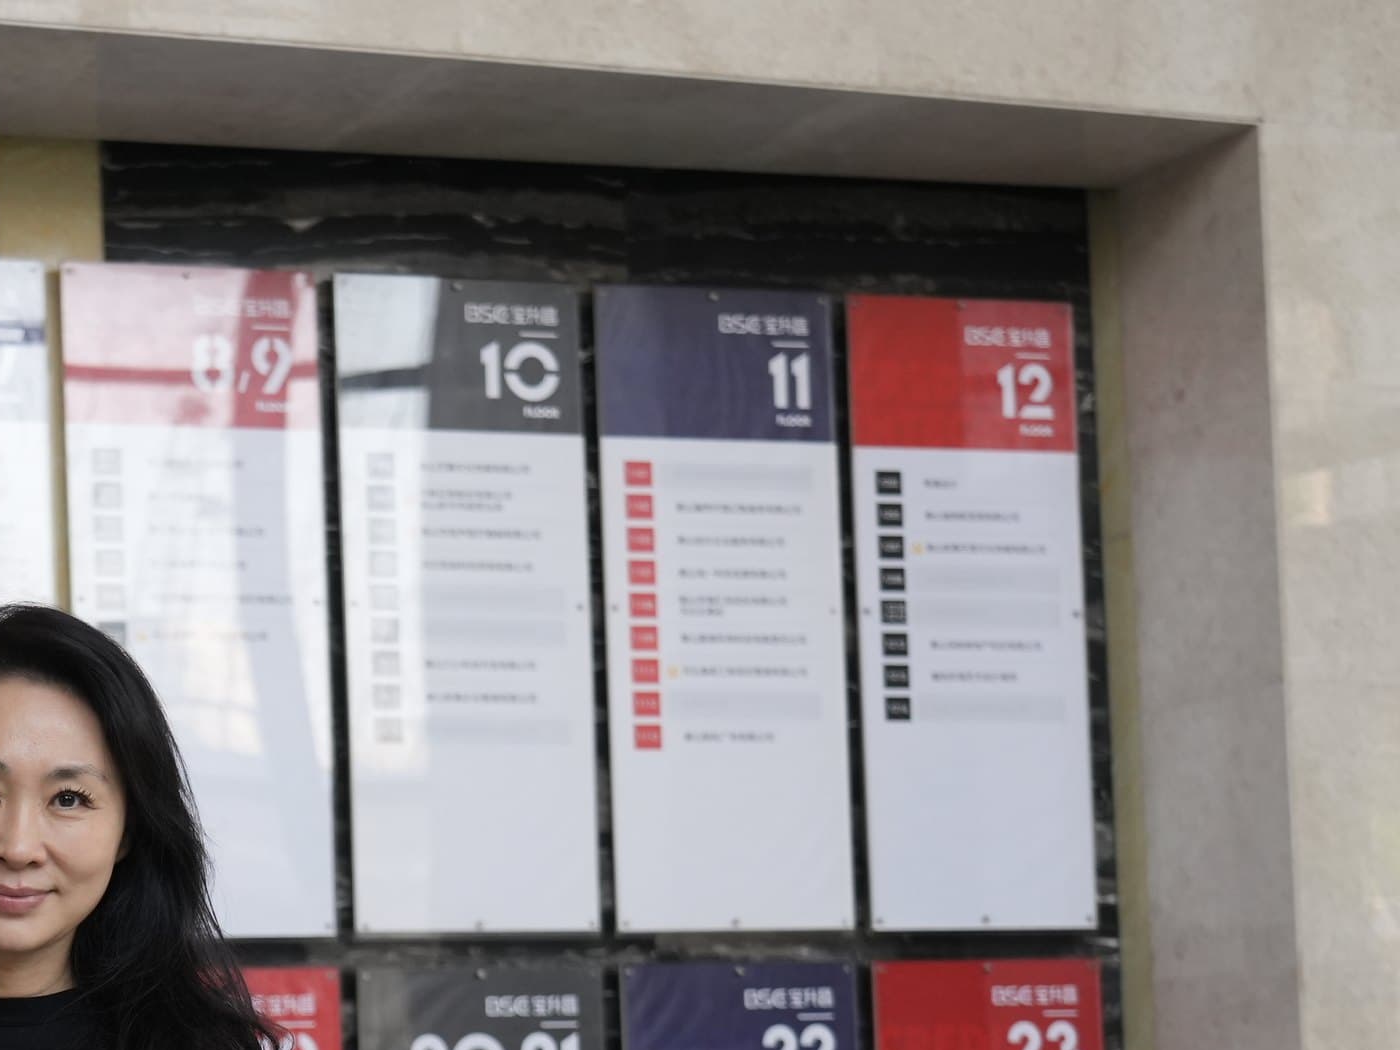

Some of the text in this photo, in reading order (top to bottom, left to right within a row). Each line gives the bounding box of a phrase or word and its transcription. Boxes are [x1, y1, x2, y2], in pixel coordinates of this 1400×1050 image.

[480, 341, 560, 402] 10
[769, 352, 811, 410] 11
[997, 363, 1054, 419] 12
